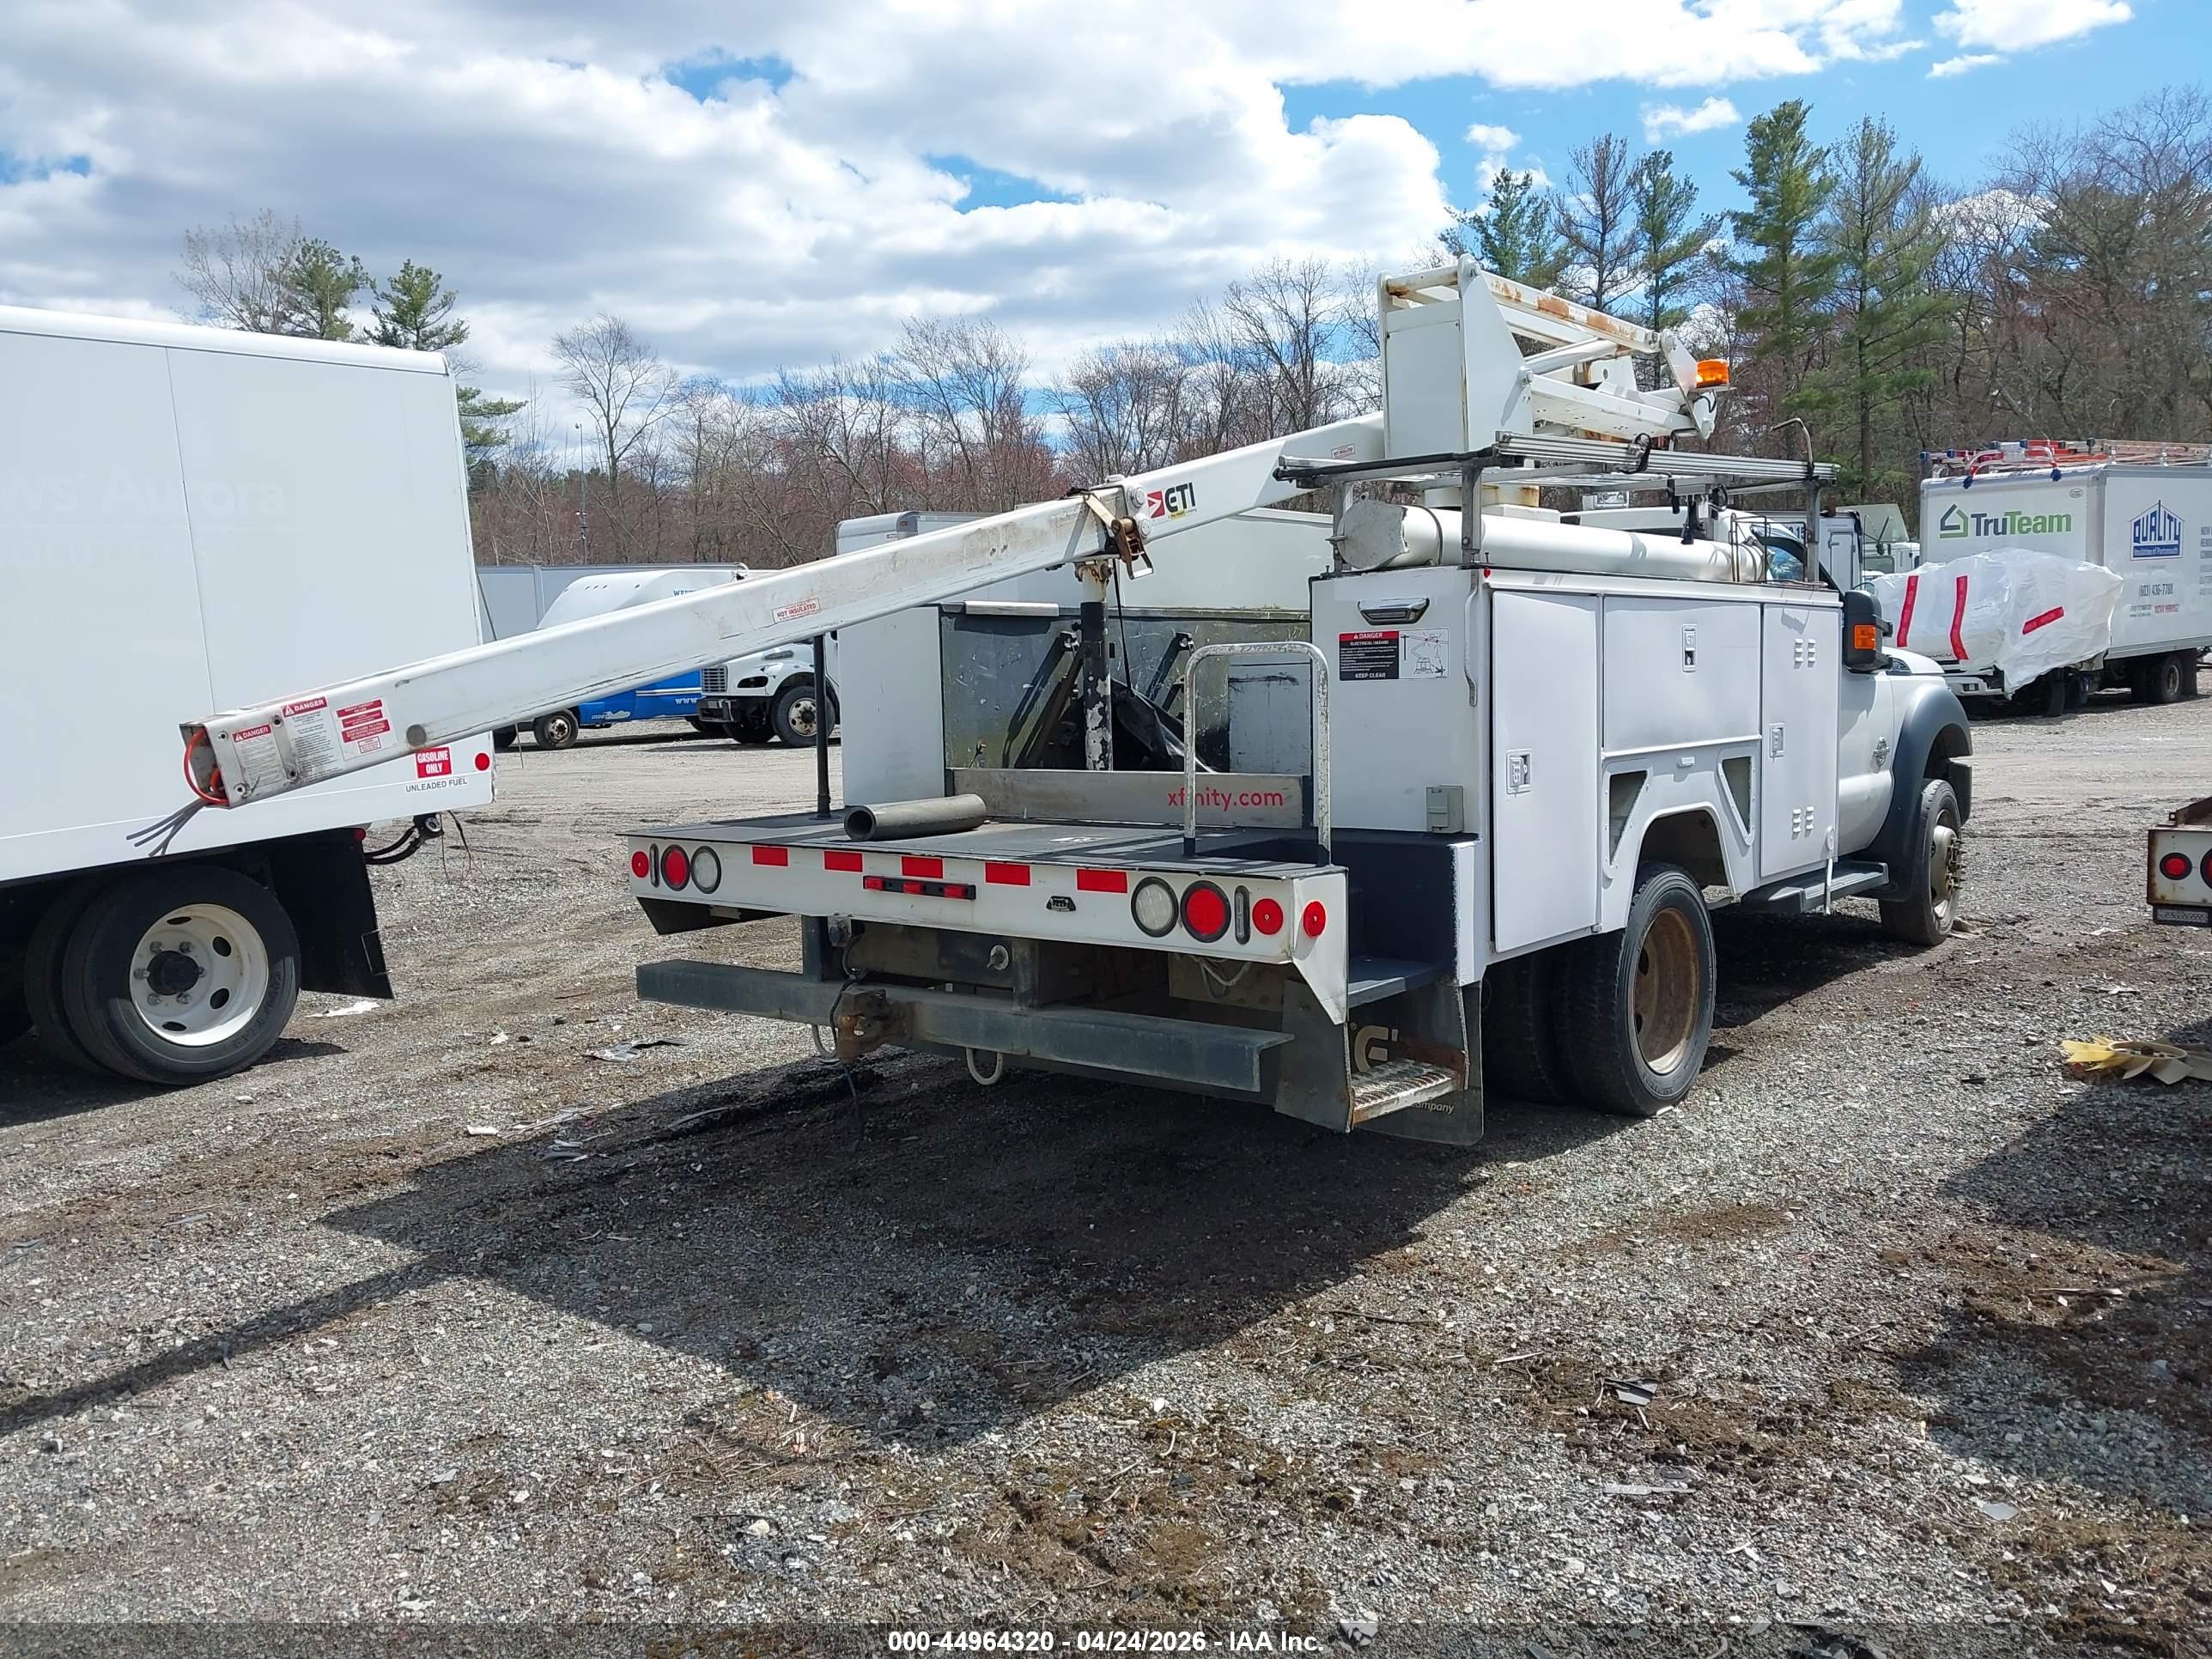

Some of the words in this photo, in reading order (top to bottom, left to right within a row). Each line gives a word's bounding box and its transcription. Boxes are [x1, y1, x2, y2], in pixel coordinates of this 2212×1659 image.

[1165, 482, 1195, 513] ETI
[1971, 511, 2072, 537] TruTeam
[2133, 500, 2181, 544] QUALITY
[789, 603, 817, 614] INSULATED
[295, 699, 324, 712] DANGER
[243, 726, 268, 738] DANGER
[417, 750, 449, 763] GASOLINE
[426, 763, 442, 775] ONLY
[405, 781, 447, 793] UNLEADED
[449, 778, 468, 787] FUEL
[1168, 787, 1284, 811] xfnity.com
[1411, 1102, 1454, 1114] ompany
